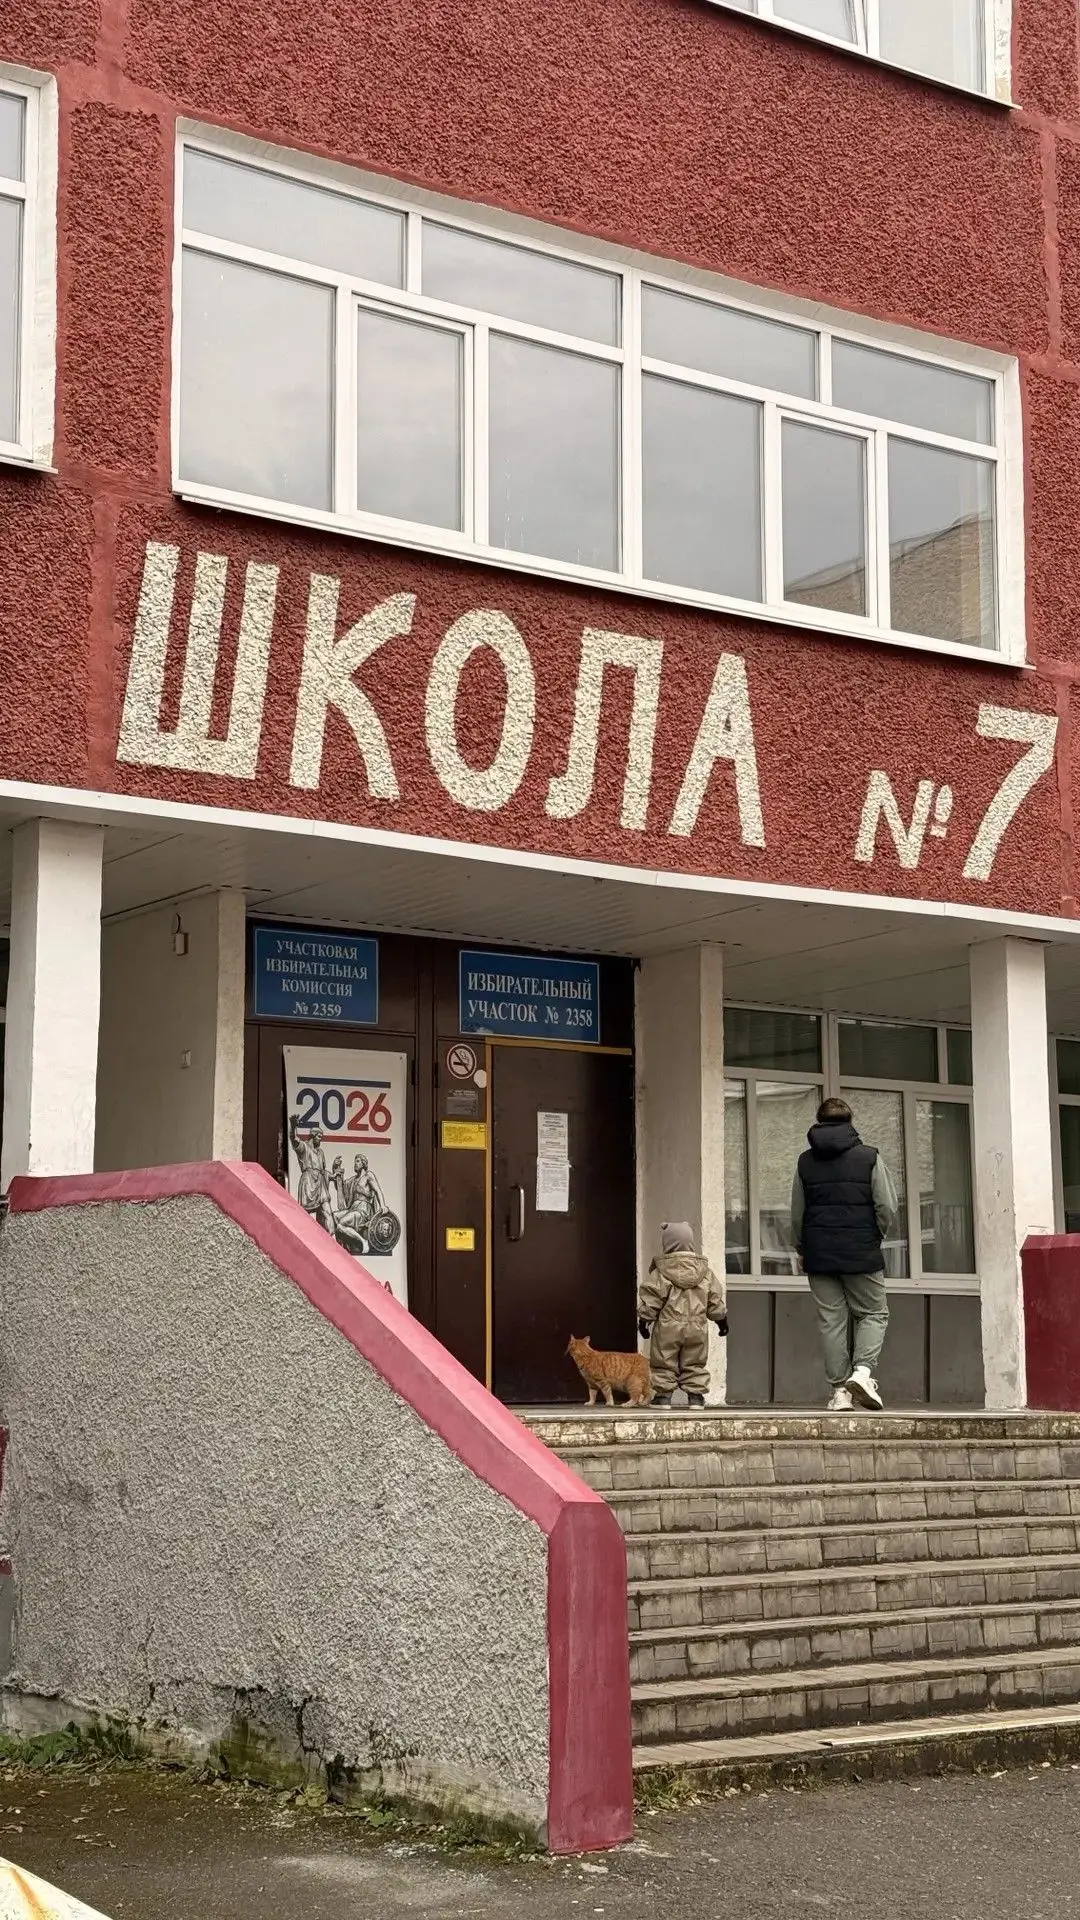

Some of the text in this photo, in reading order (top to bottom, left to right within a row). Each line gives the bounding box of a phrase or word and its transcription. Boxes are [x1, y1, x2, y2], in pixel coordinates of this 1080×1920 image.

[115, 541, 1059, 882] ШКОЛА № 7
[277, 940, 358, 960] УЧАСТКОВАЯ
[266, 958, 368, 980] ИЗБИРАТЕЛЬНАЯ
[282, 979, 353, 997] КОМИССИЯ
[467, 972, 593, 1000] ИЗБИРАТЕЛЬНЫЙ
[293, 1002, 342, 1017] № 2359
[467, 1000, 593, 1027] УЧАСТОК № 2358
[296, 1088, 392, 1133] 2026
